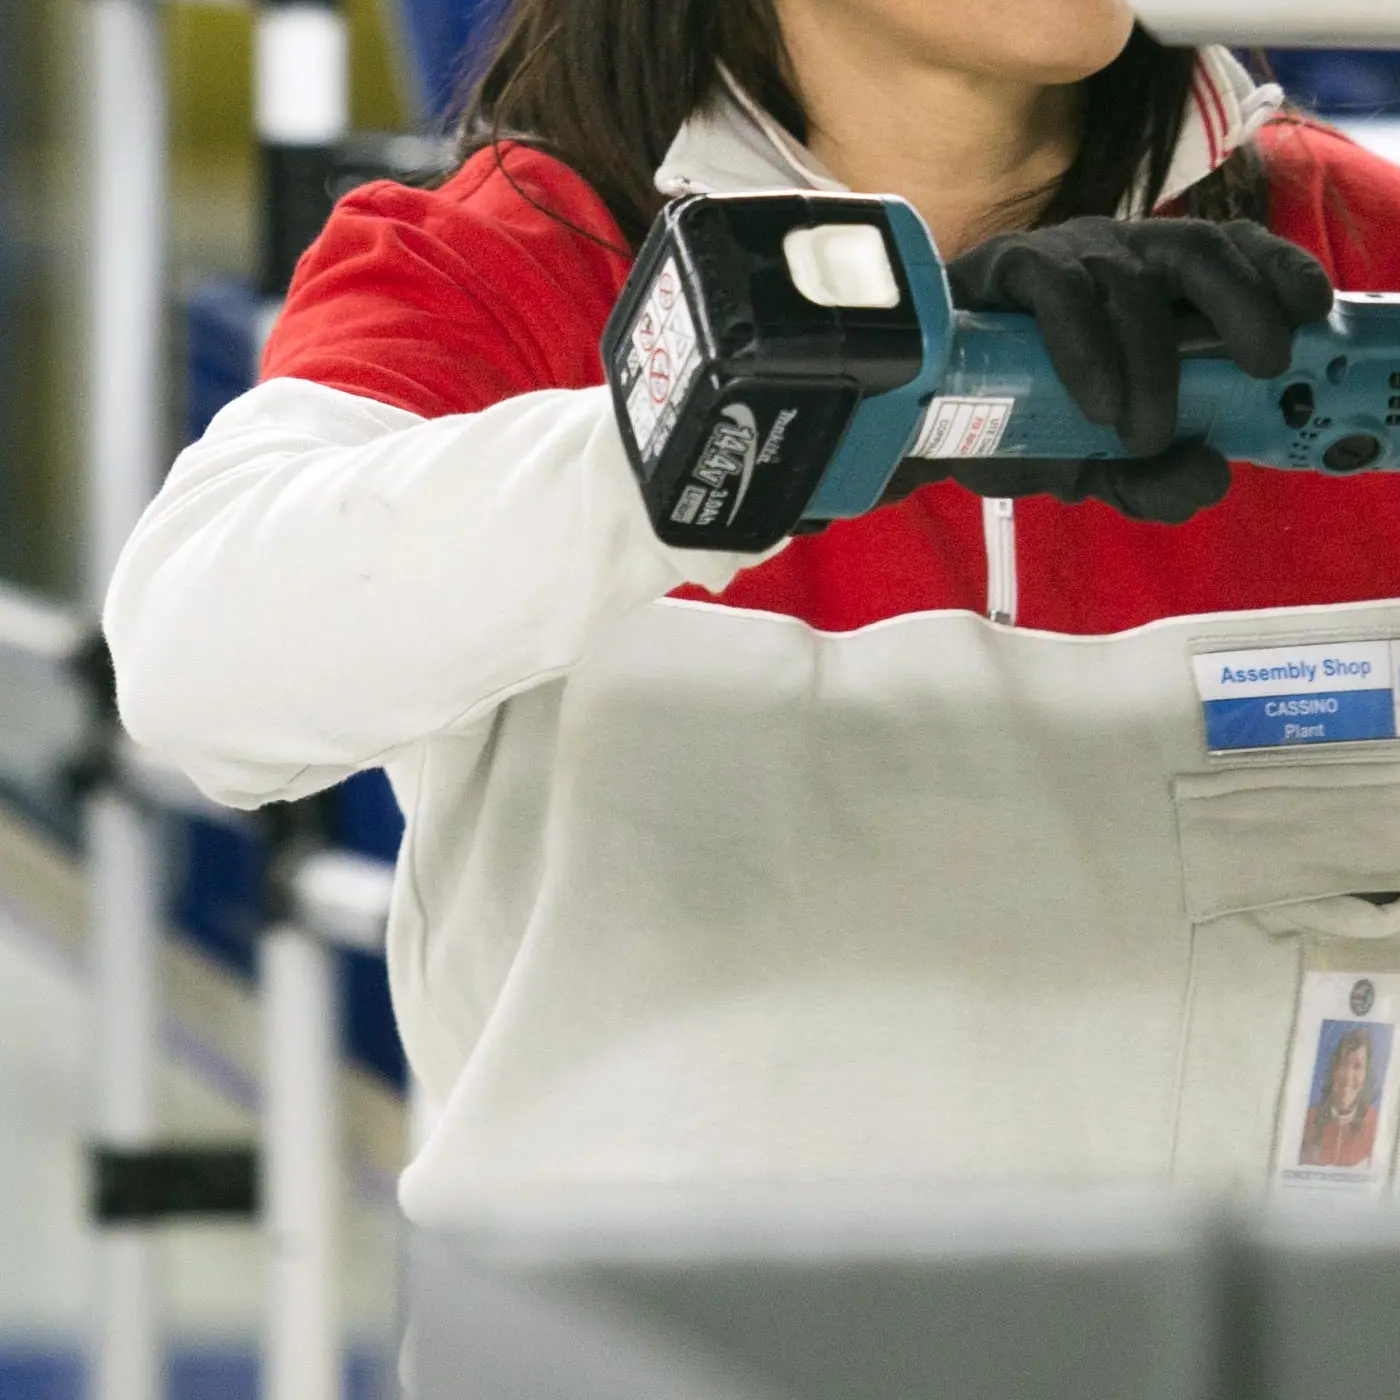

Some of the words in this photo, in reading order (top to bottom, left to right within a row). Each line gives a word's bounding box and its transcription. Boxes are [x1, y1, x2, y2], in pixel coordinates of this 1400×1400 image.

[1221, 661, 1317, 684] Assembly
[1323, 658, 1371, 678] Shop
[1265, 697, 1338, 717] CASSINO
[1284, 723, 1325, 739] Plant
